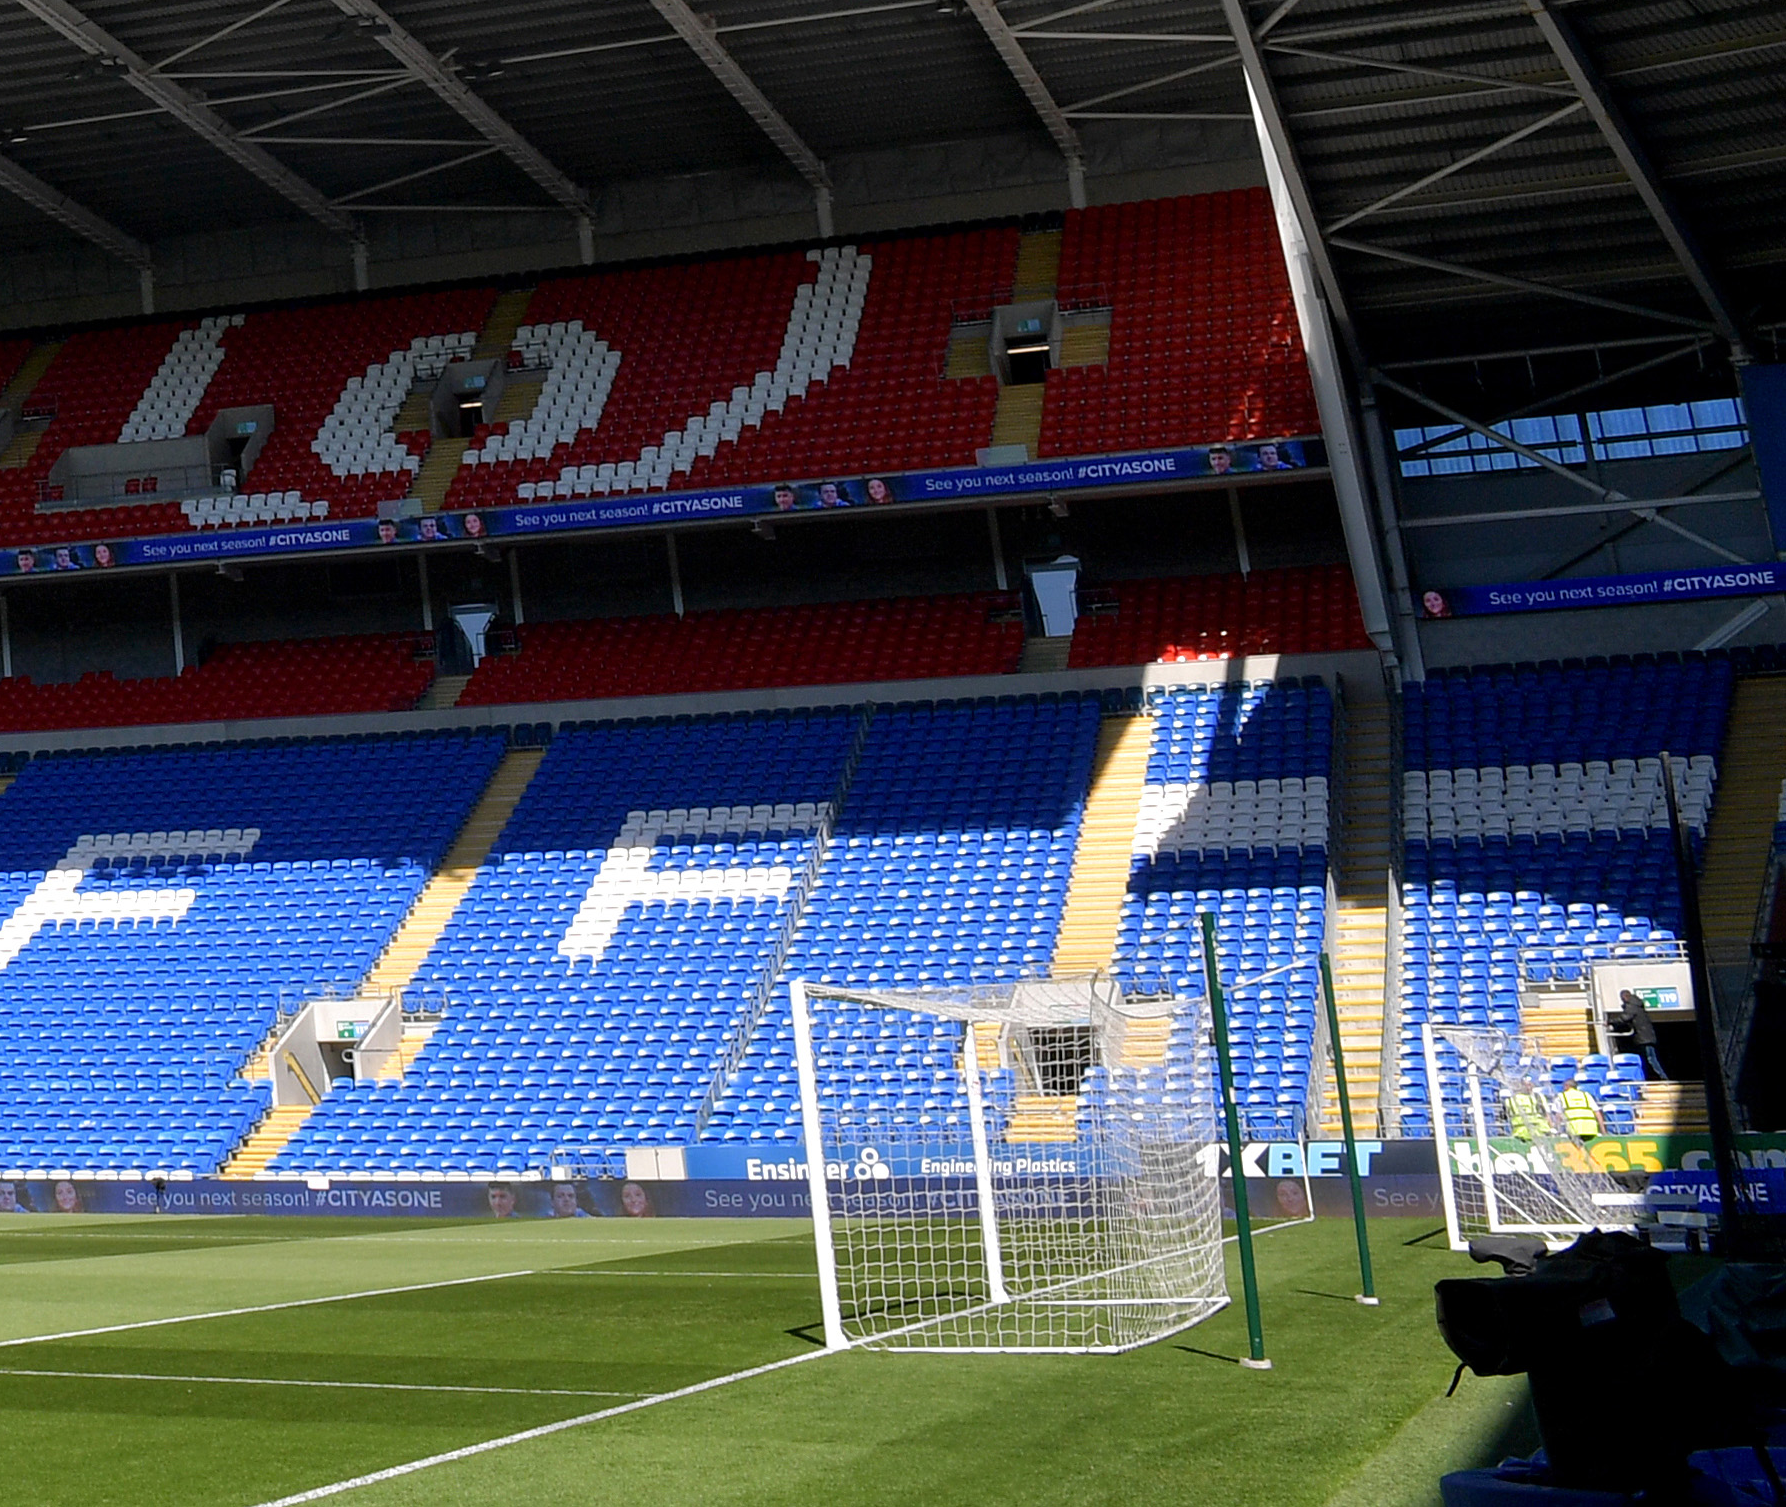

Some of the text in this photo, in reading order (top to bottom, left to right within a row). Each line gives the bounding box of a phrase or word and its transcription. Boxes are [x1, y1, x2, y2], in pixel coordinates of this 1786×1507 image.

[925, 459, 1175, 491] See you next season! #CITYASONE
[515, 497, 742, 526] See you next season! #CITYASONE
[143, 530, 350, 558] See you next season! #CITYASONE
[1490, 572, 1774, 605] See you next season! #CITYASONE
[746, 1158, 1076, 1181] Ensiner Engineing Plastics
[125, 1190, 442, 1210] See you next season! #CITYASONE
[705, 1190, 743, 1207] See
[751, 1193, 785, 1211] you
[792, 1192, 833, 1207] net
[1374, 1190, 1418, 1207] See
